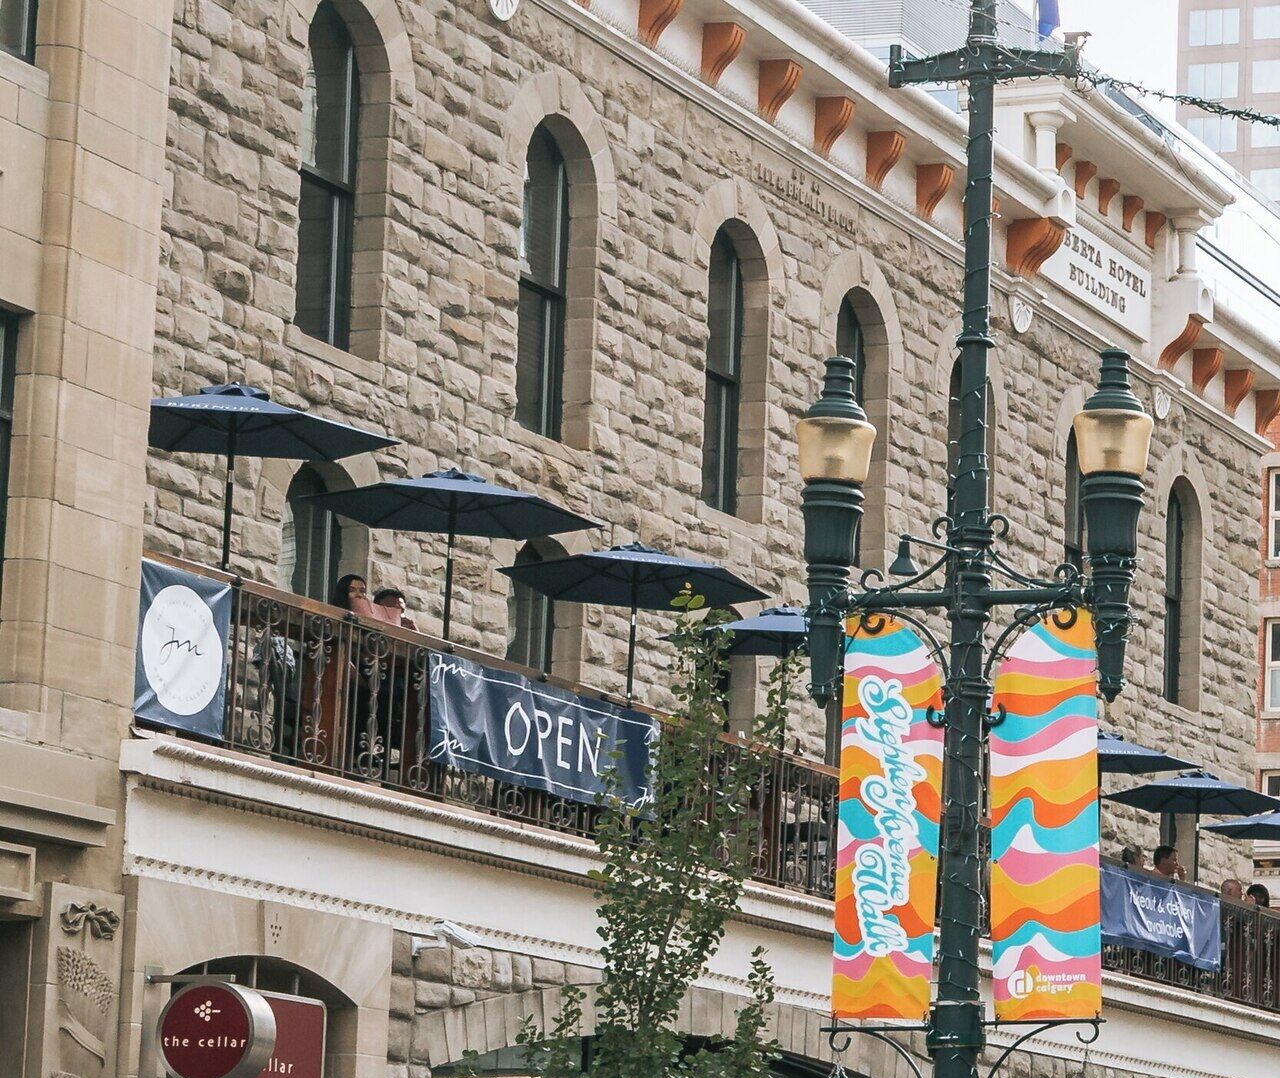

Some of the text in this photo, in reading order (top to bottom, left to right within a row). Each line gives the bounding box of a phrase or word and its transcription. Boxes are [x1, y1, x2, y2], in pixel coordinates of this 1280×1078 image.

[1064, 229, 1146, 298] BERTA HOTEL
[1069, 262, 1126, 313] BUILDING
[504, 702, 602, 776] OPEN
[1147, 919, 1184, 939] available
[1036, 973, 1086, 982] downtown
[1036, 983, 1073, 994] calgary
[164, 1036, 246, 1048] the cellar
[268, 1058, 294, 1074] llar
